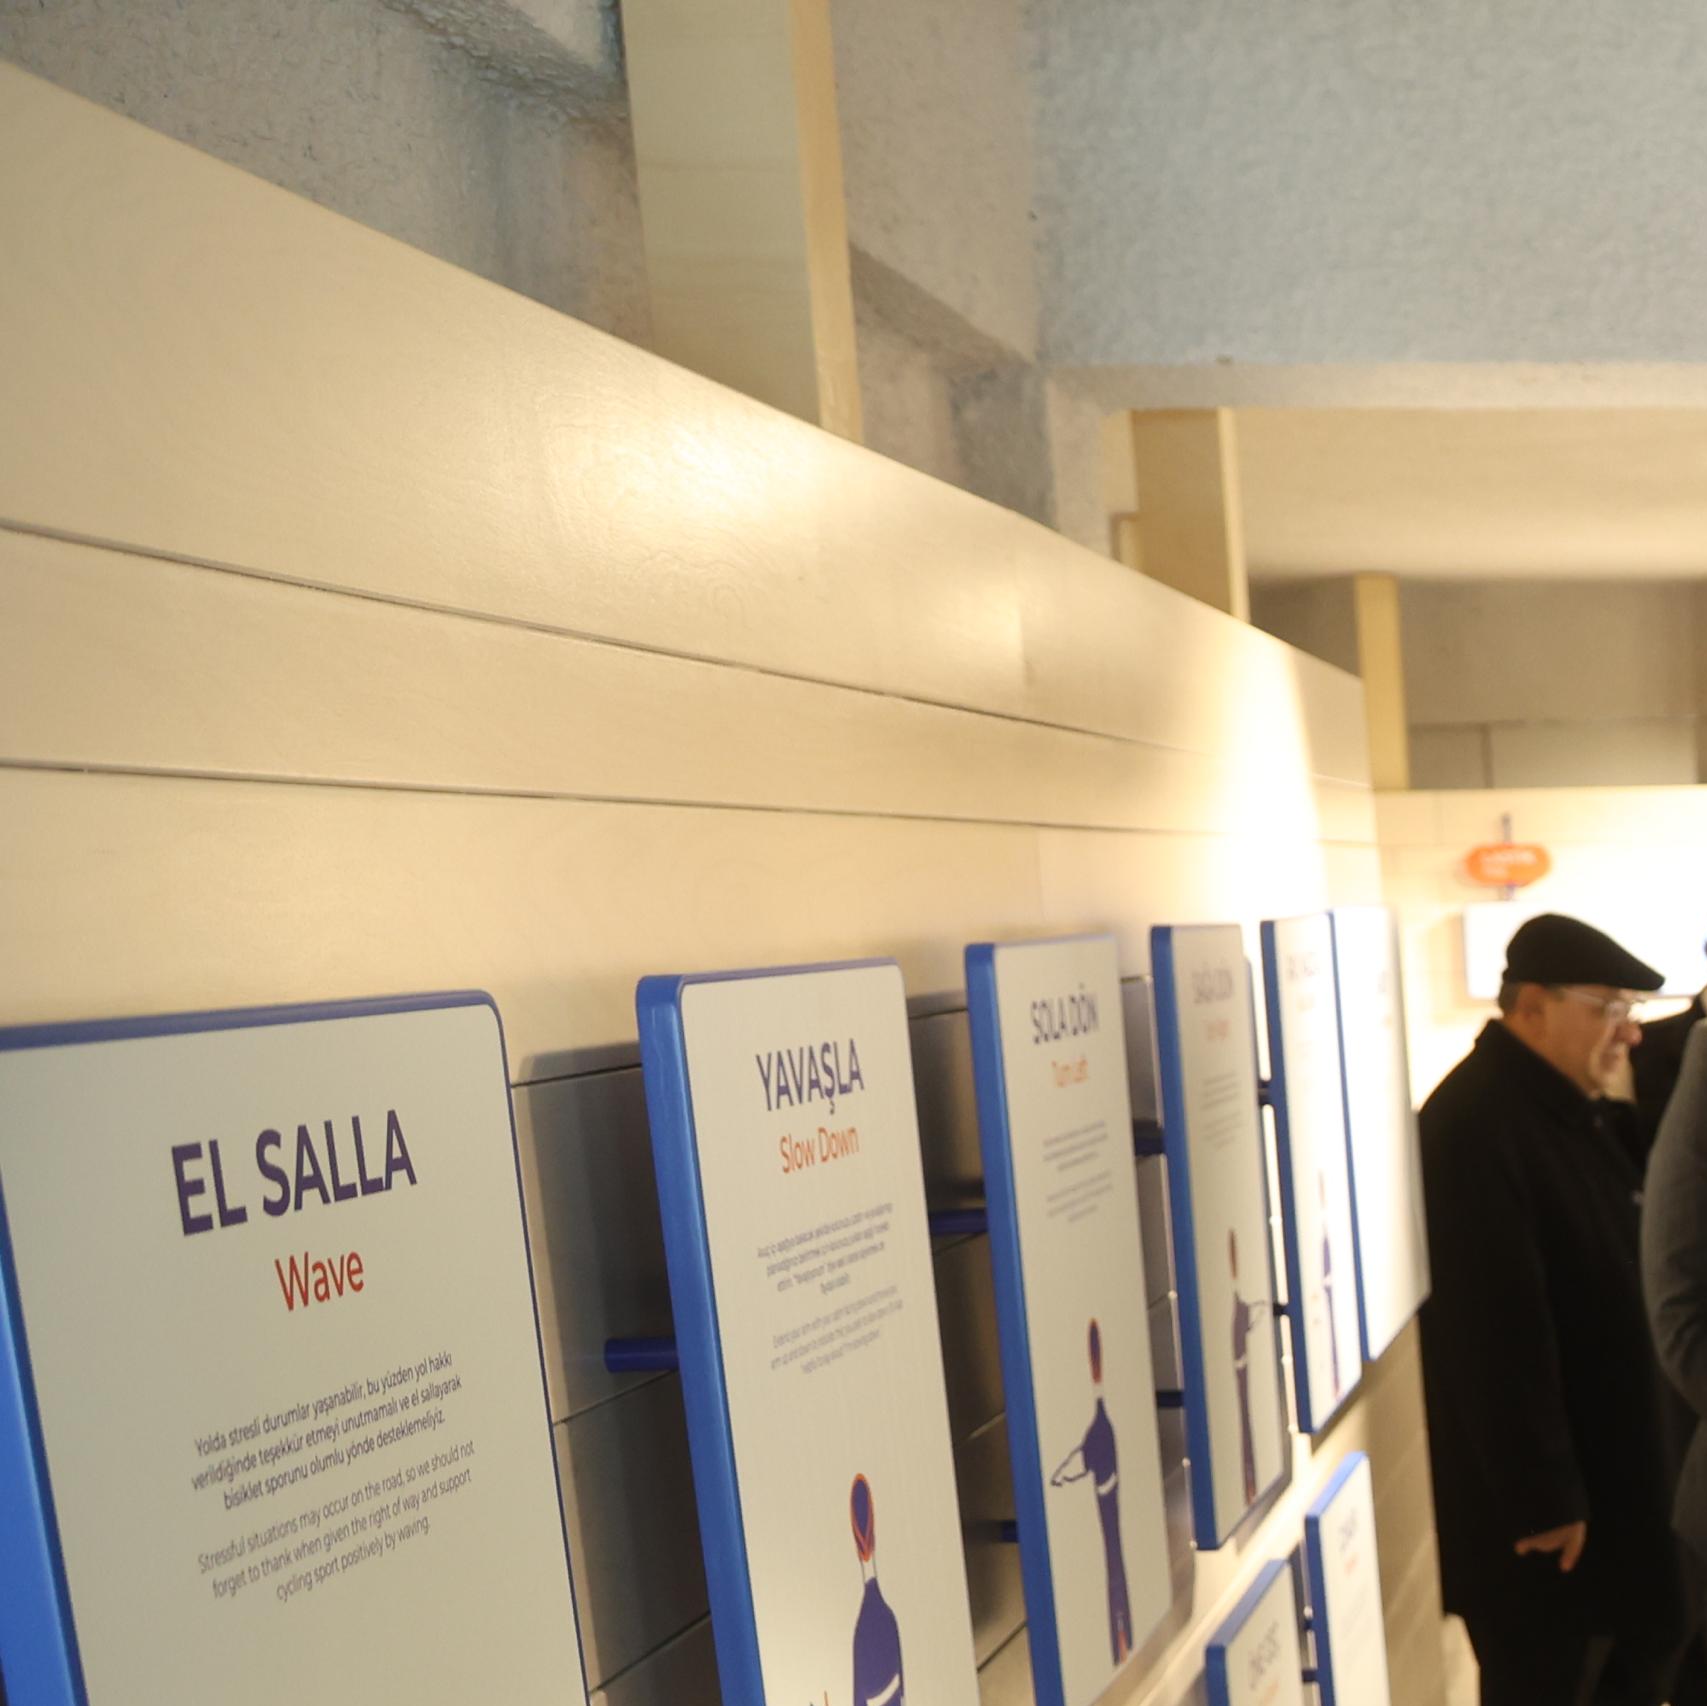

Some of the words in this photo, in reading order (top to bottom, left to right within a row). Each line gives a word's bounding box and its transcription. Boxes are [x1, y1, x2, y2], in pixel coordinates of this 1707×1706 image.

[755, 1037, 865, 1115] YAVAŞLA
[170, 1138, 248, 1237] EL
[255, 1108, 418, 1218] SALLA
[779, 1132, 815, 1174] Slow
[817, 1126, 860, 1163] Down
[274, 1250, 365, 1312] Wave
[191, 1452, 257, 1492] verildiğinde
[258, 1435, 304, 1466] teşekkür
[305, 1417, 341, 1448] etmeyi
[341, 1396, 399, 1434] unutmamalı
[398, 1395, 410, 1411] ve
[410, 1388, 420, 1407] el
[420, 1373, 463, 1404] sallayarak
[194, 1431, 227, 1457] Yolda
[228, 1416, 262, 1447] stresli
[262, 1402, 310, 1435] durumlar
[311, 1382, 367, 1421] yaşanabilir,
[366, 1377, 380, 1396] bu
[380, 1366, 414, 1396] yüzden
[414, 1357, 428, 1382] yol
[427, 1351, 453, 1373] hakkı
[197, 1535, 246, 1575] Stressful
[246, 1517, 299, 1553] situations
[299, 1508, 321, 1529] may
[322, 1495, 349, 1520] occur
[350, 1488, 365, 1507] on
[364, 1481, 381, 1501] the
[381, 1467, 406, 1492] road,
[405, 1466, 417, 1484] so
[416, 1459, 430, 1477] we
[431, 1444, 460, 1473] should
[459, 1439, 476, 1459] not
[223, 1479, 264, 1511] bisiklet
[264, 1464, 309, 1497] sporunu
[309, 1447, 345, 1476] olumlu
[345, 1436, 375, 1467] yönde
[376, 1409, 446, 1449] desteklemeliyiz.
[212, 1569, 247, 1599] forget
[247, 1565, 261, 1584] to
[260, 1548, 293, 1577] thank
[292, 1537, 322, 1562] when
[323, 1523, 350, 1553] given
[350, 1516, 368, 1536] the
[368, 1503, 392, 1529] right
[392, 1495, 401, 1517] of
[402, 1494, 420, 1512] way
[421, 1480, 439, 1504] and
[438, 1468, 472, 1496] support
[276, 1571, 313, 1604] cycling
[313, 1556, 341, 1585] sport
[340, 1536, 384, 1574] positively
[384, 1532, 396, 1551] by
[396, 1515, 431, 1543] waving.
